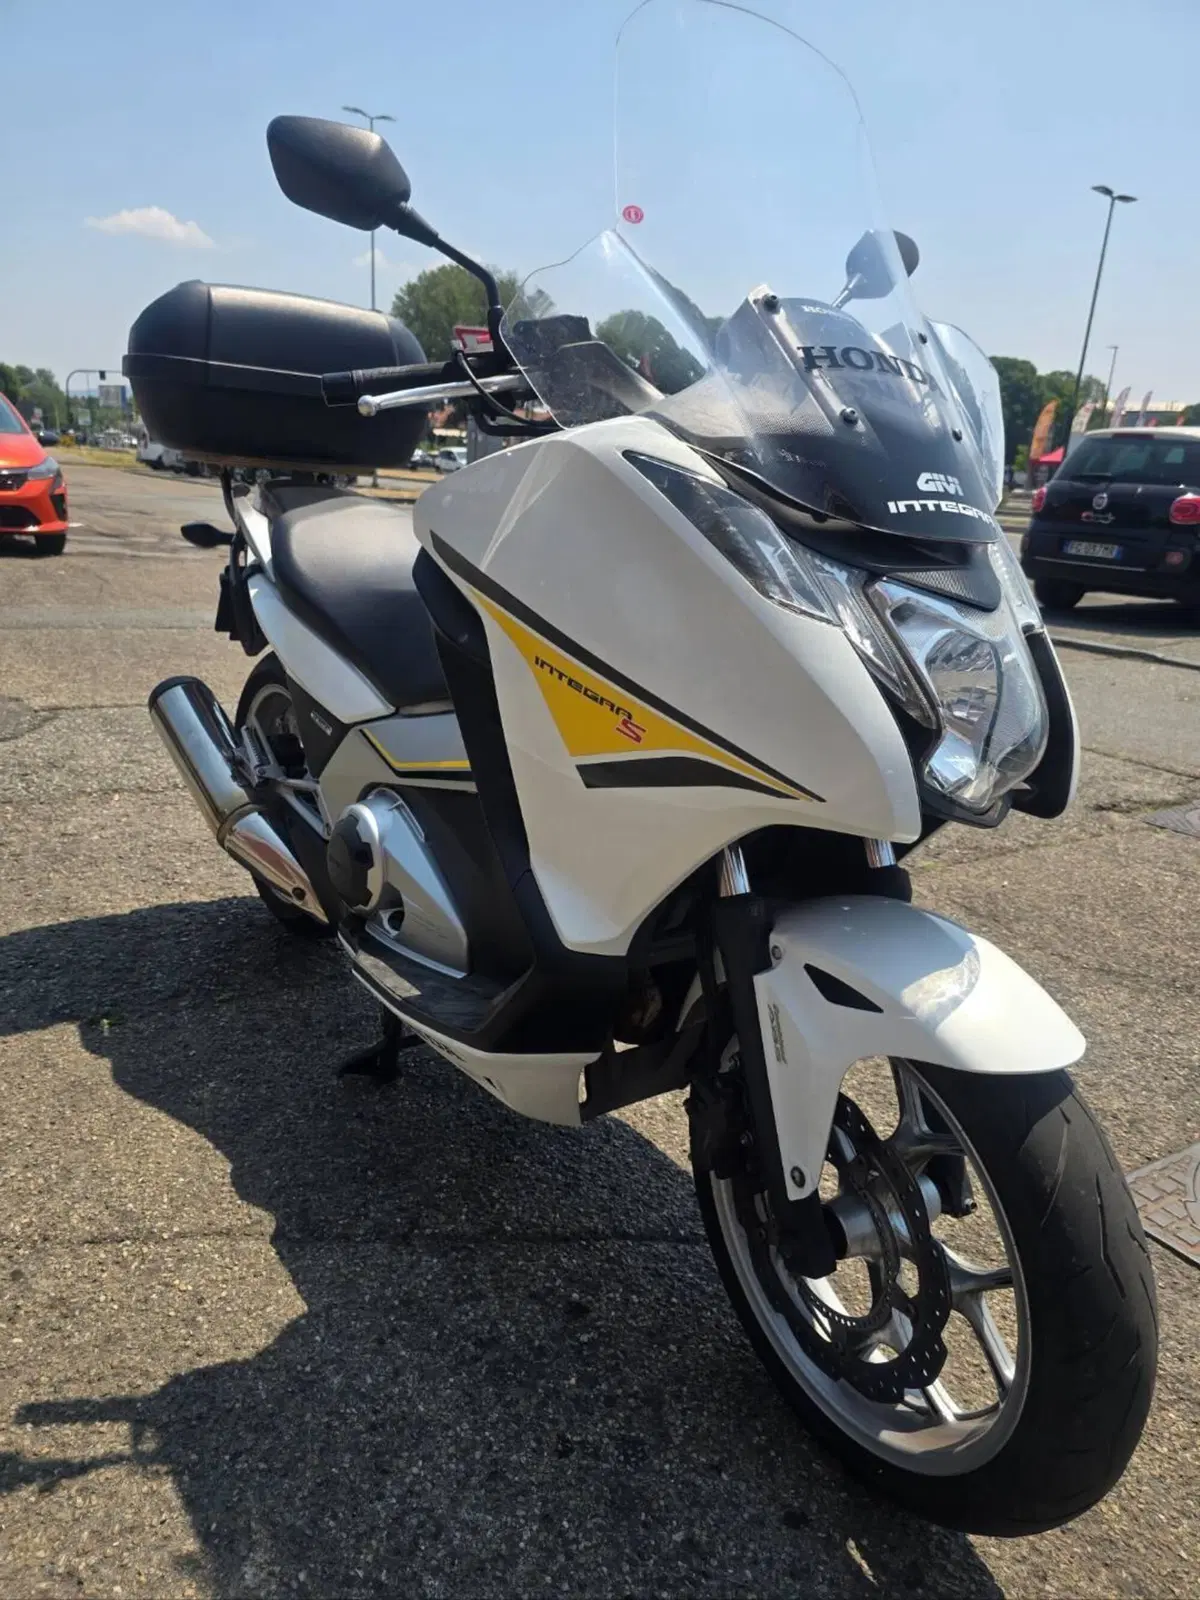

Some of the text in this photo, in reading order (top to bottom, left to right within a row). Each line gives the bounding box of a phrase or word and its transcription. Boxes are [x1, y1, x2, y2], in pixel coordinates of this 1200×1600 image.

[917, 472, 964, 496] GIVI
[535, 655, 646, 743] INTEGRA S
